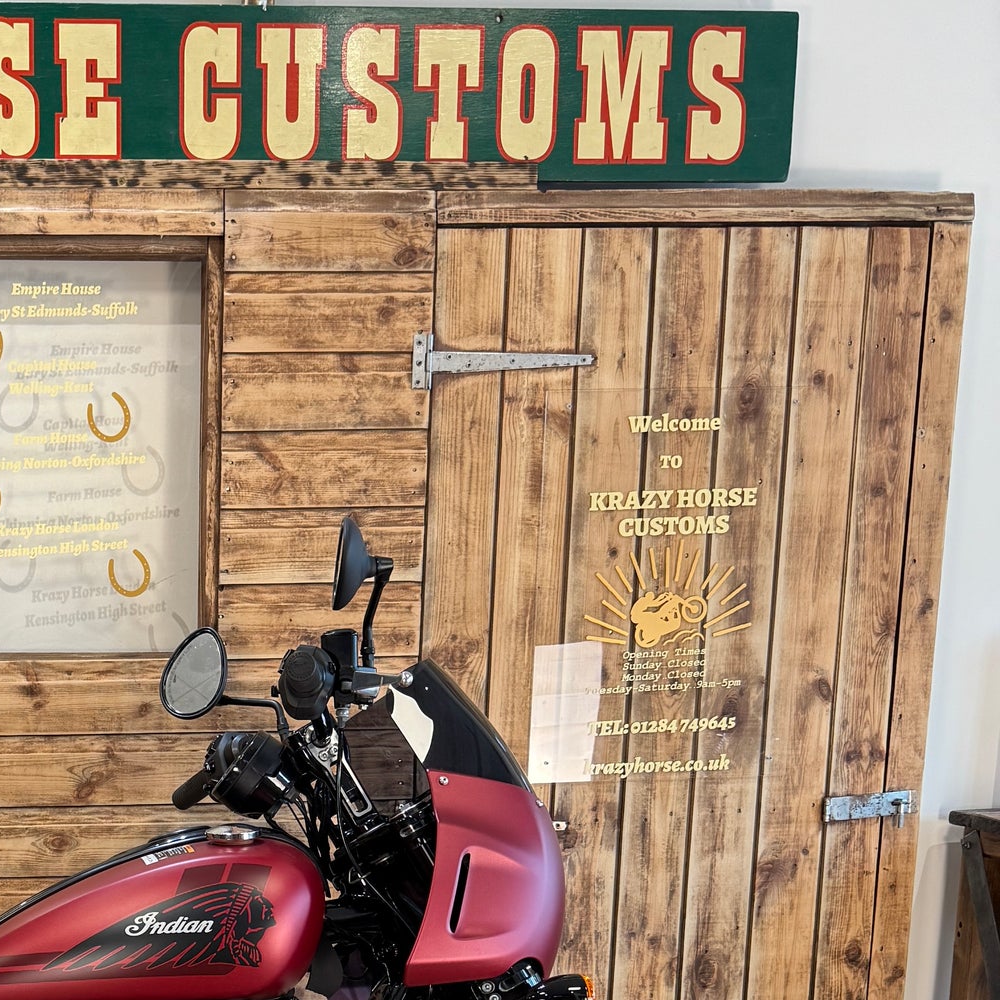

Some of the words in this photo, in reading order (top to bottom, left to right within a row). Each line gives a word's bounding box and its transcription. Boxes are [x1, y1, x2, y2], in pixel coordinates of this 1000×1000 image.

[180, 21, 747, 165] CUSTOMS
[11, 282, 59, 299] Empire
[61, 282, 102, 296] House
[11, 305, 26, 318] St
[27, 301, 138, 319] Edmunds-Suffolk
[58, 359, 97, 372] House
[8, 381, 94, 397] Welling-Kent
[628, 413, 721, 434] Welcome
[13, 433, 47, 446] Farm
[49, 431, 89, 445] House
[23, 453, 146, 471] Norton-Oxfordshire
[659, 455, 683, 469] TO
[589, 489, 676, 512] KRAZY
[676, 487, 758, 508] HORSE
[35, 522, 71, 536] Horse
[72, 519, 119, 533] London
[619, 515, 730, 537] CUSTOMS
[59, 541, 90, 555] High
[91, 538, 129, 552] Street
[622, 650, 669, 662] Opening
[674, 647, 707, 657] Times
[680, 716, 736, 733] 749645
[583, 754, 730, 779] krazyhorse.co.uk
[125, 911, 214, 937] Indian
